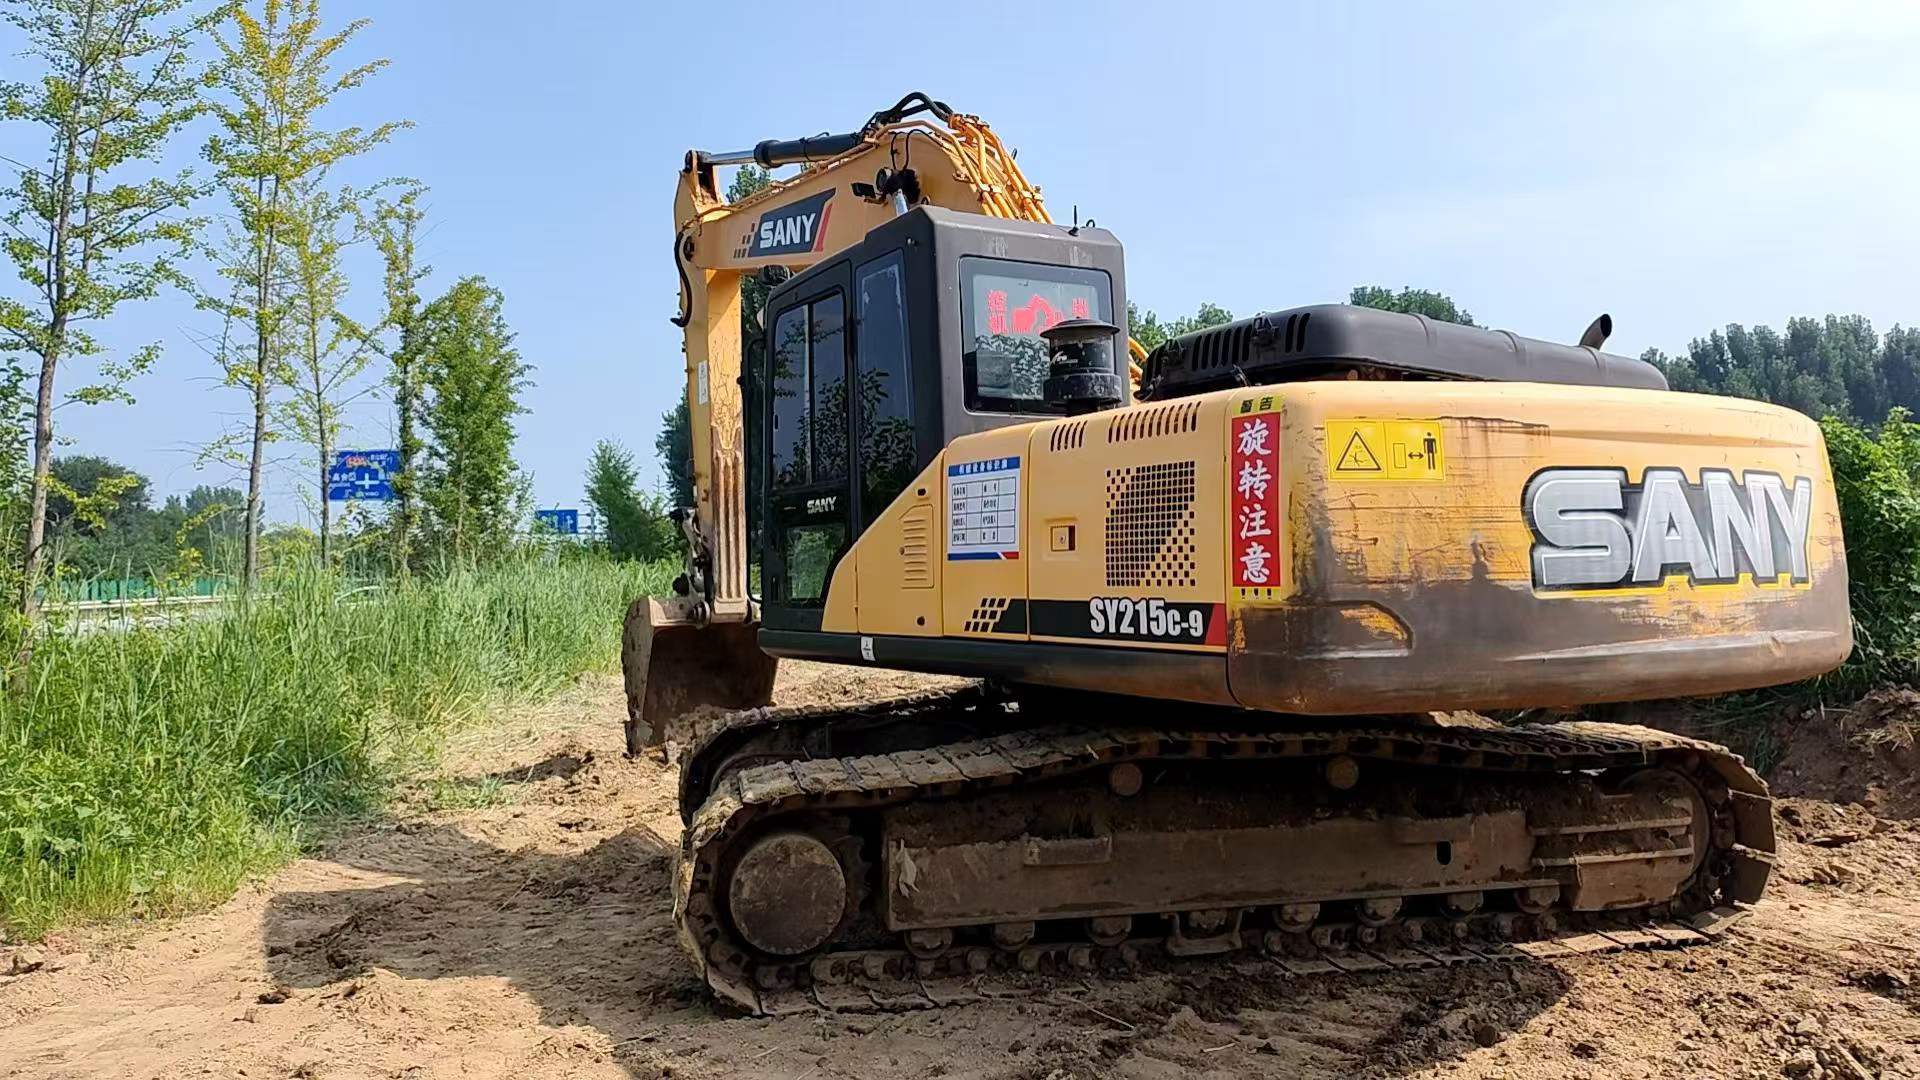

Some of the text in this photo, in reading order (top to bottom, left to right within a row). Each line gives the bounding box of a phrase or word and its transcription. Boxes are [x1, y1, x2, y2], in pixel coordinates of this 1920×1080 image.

[760, 213, 816, 249] SANY
[1240, 397, 1273, 413] 警告
[806, 496, 837, 514] SANY
[1237, 419, 1272, 583] 旋转注意
[1523, 467, 1812, 588] SANY
[1089, 598, 1204, 637] SY215C-9
